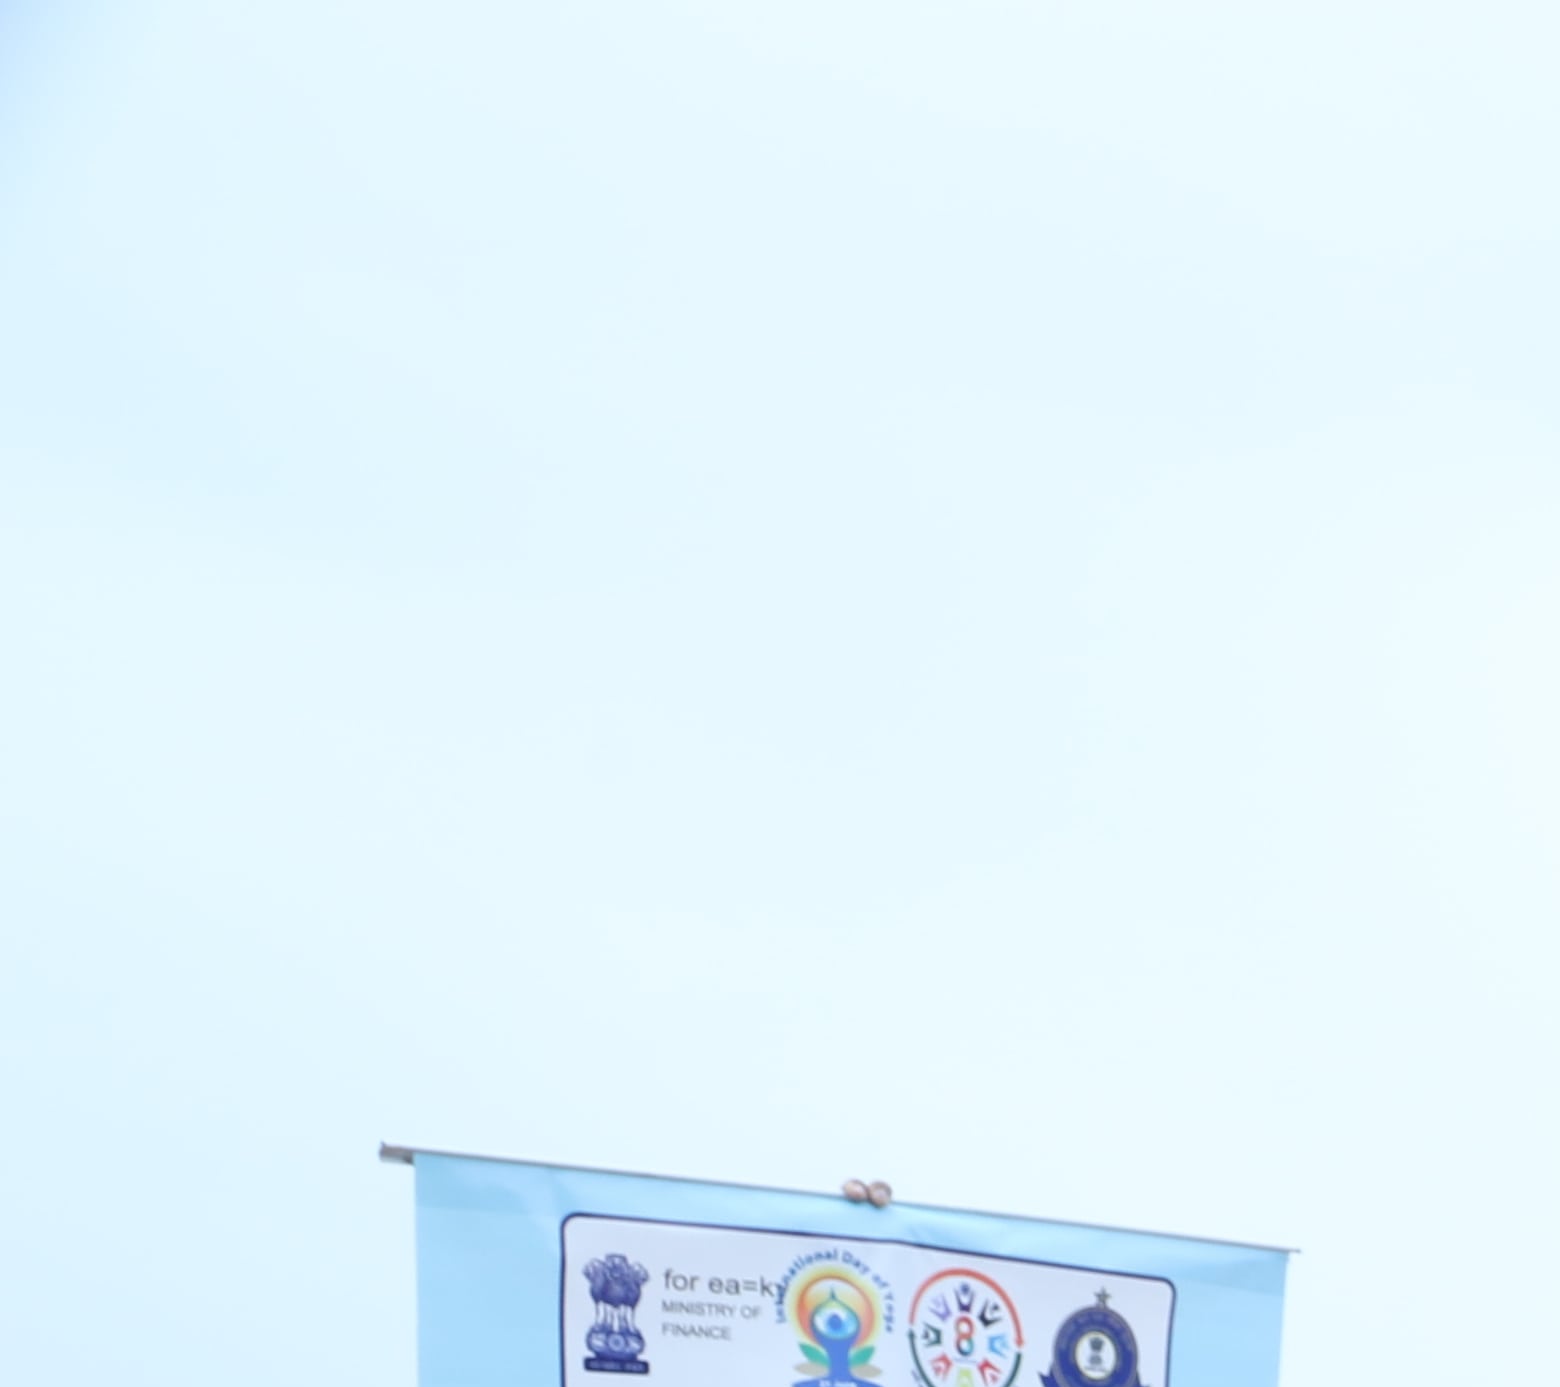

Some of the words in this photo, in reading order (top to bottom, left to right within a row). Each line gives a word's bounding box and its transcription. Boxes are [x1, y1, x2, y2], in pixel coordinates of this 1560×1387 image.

[664, 1269, 699, 1292] for
[662, 1300, 737, 1317] MINISTRY
[740, 1305, 762, 1320] OF
[662, 1324, 731, 1340] FINANCE
